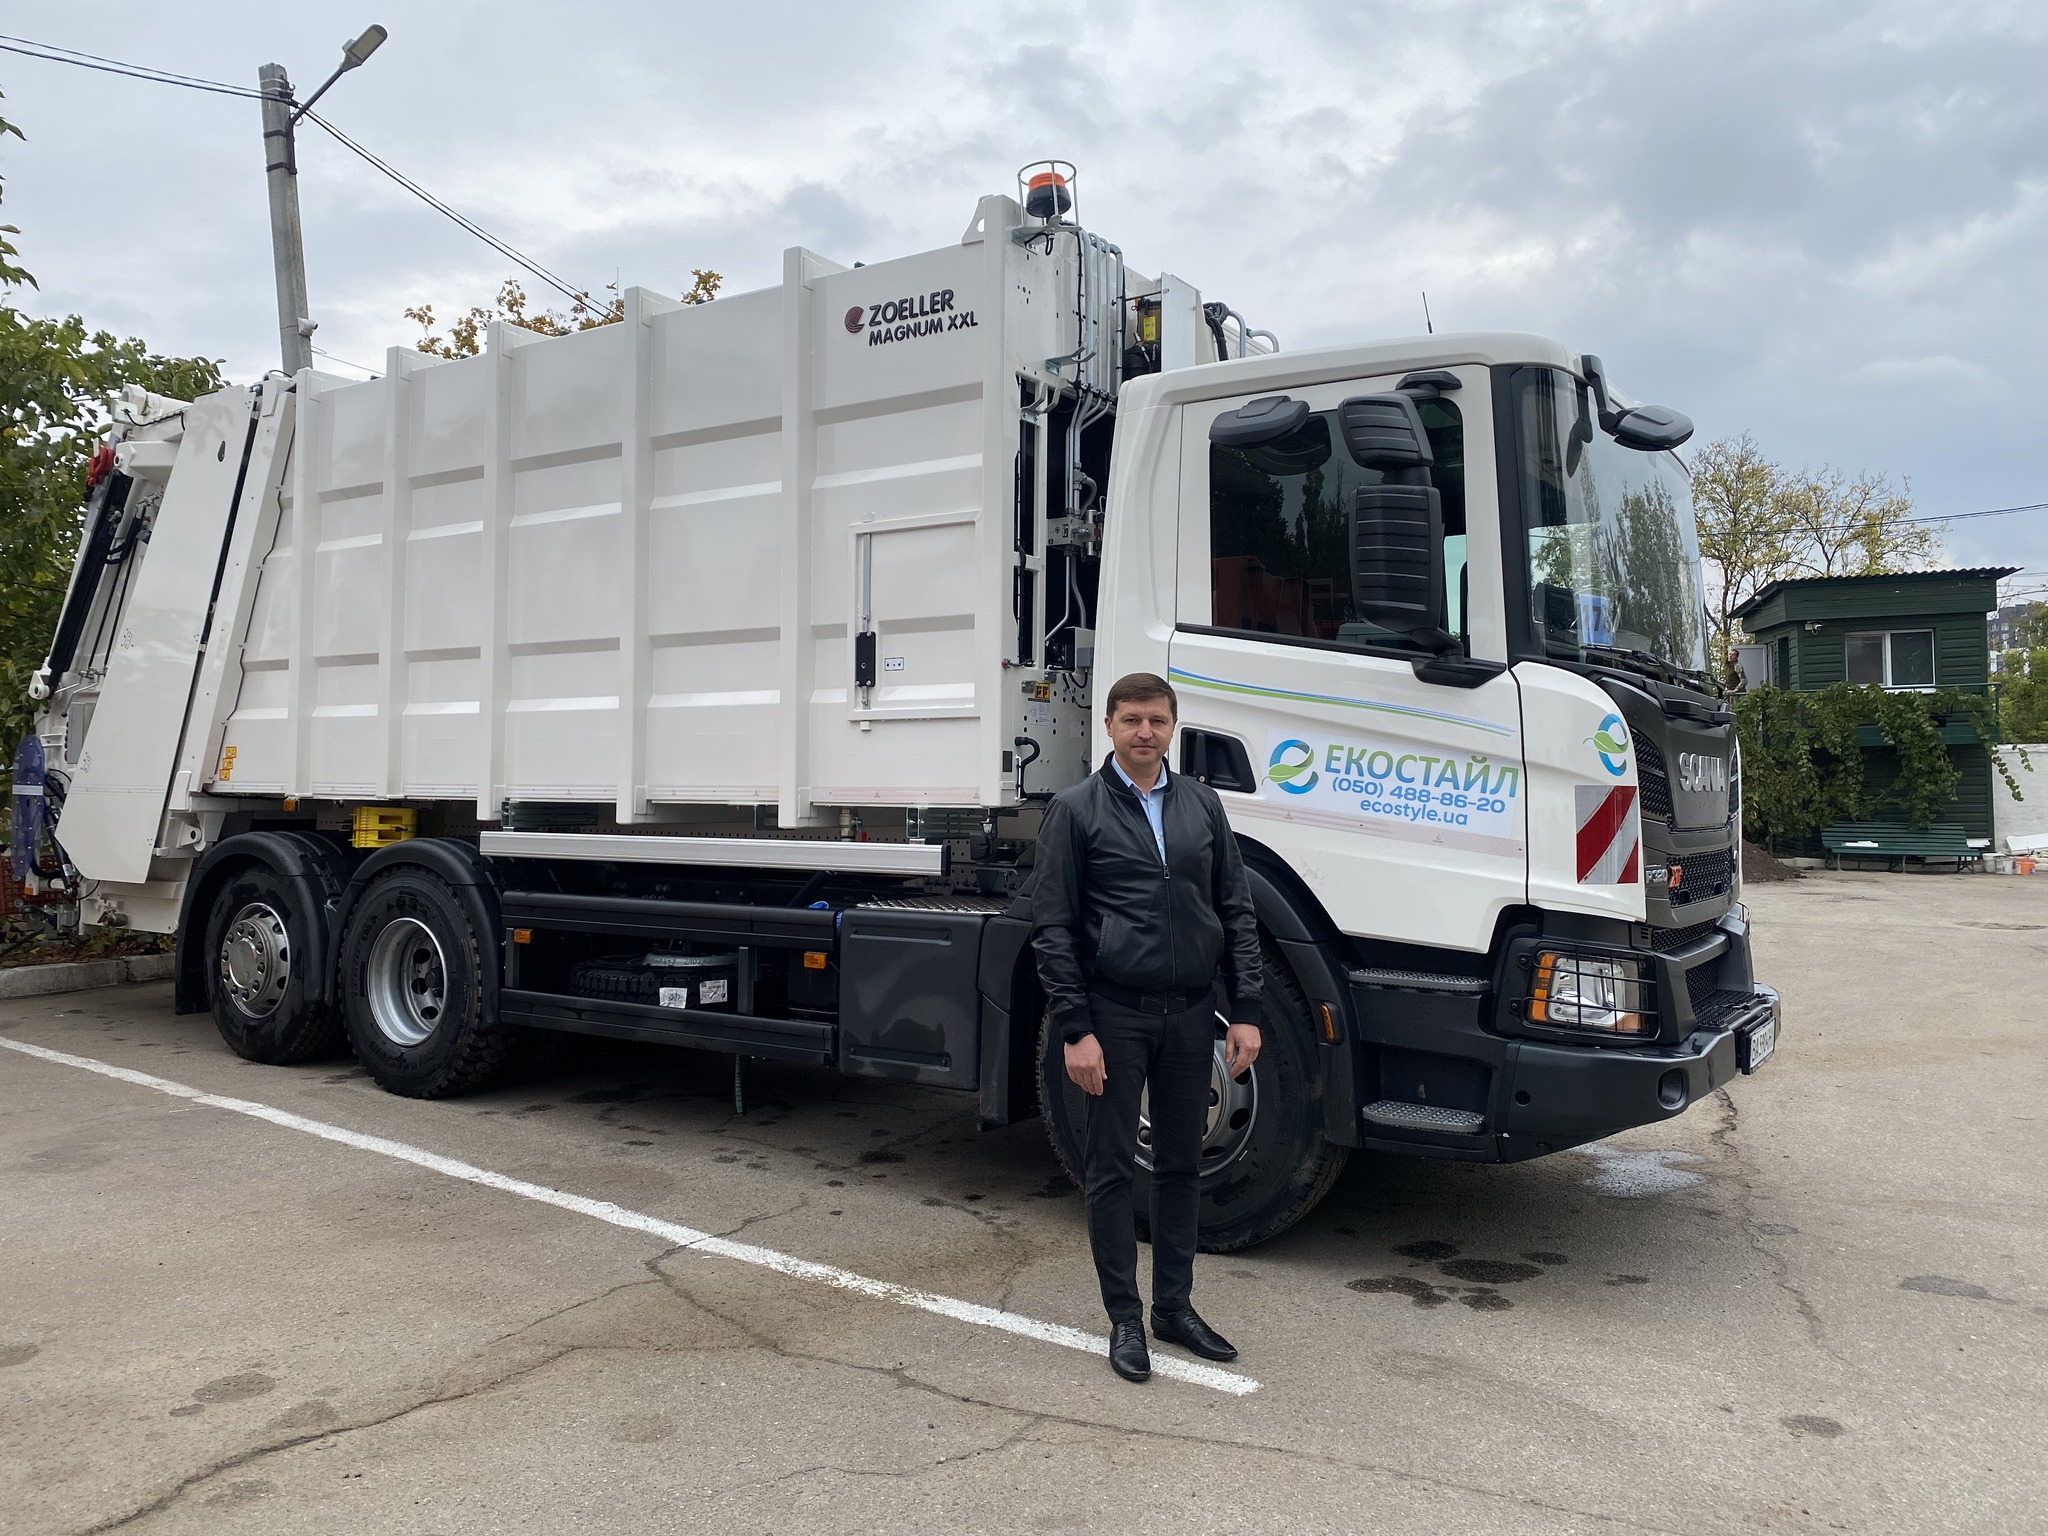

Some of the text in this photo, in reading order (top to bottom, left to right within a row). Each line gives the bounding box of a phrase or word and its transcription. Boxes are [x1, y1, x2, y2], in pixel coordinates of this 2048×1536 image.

[868, 289, 954, 327] ZOELLER
[869, 311, 979, 347] MAGNUM XXL
[1325, 744, 1519, 798] ЕКОСТАЙЛ
[1679, 752, 1726, 792] SCANIA
[1332, 777, 1506, 814] (050) 488-86-20
[1360, 799, 1468, 826] ecostyle.ua
